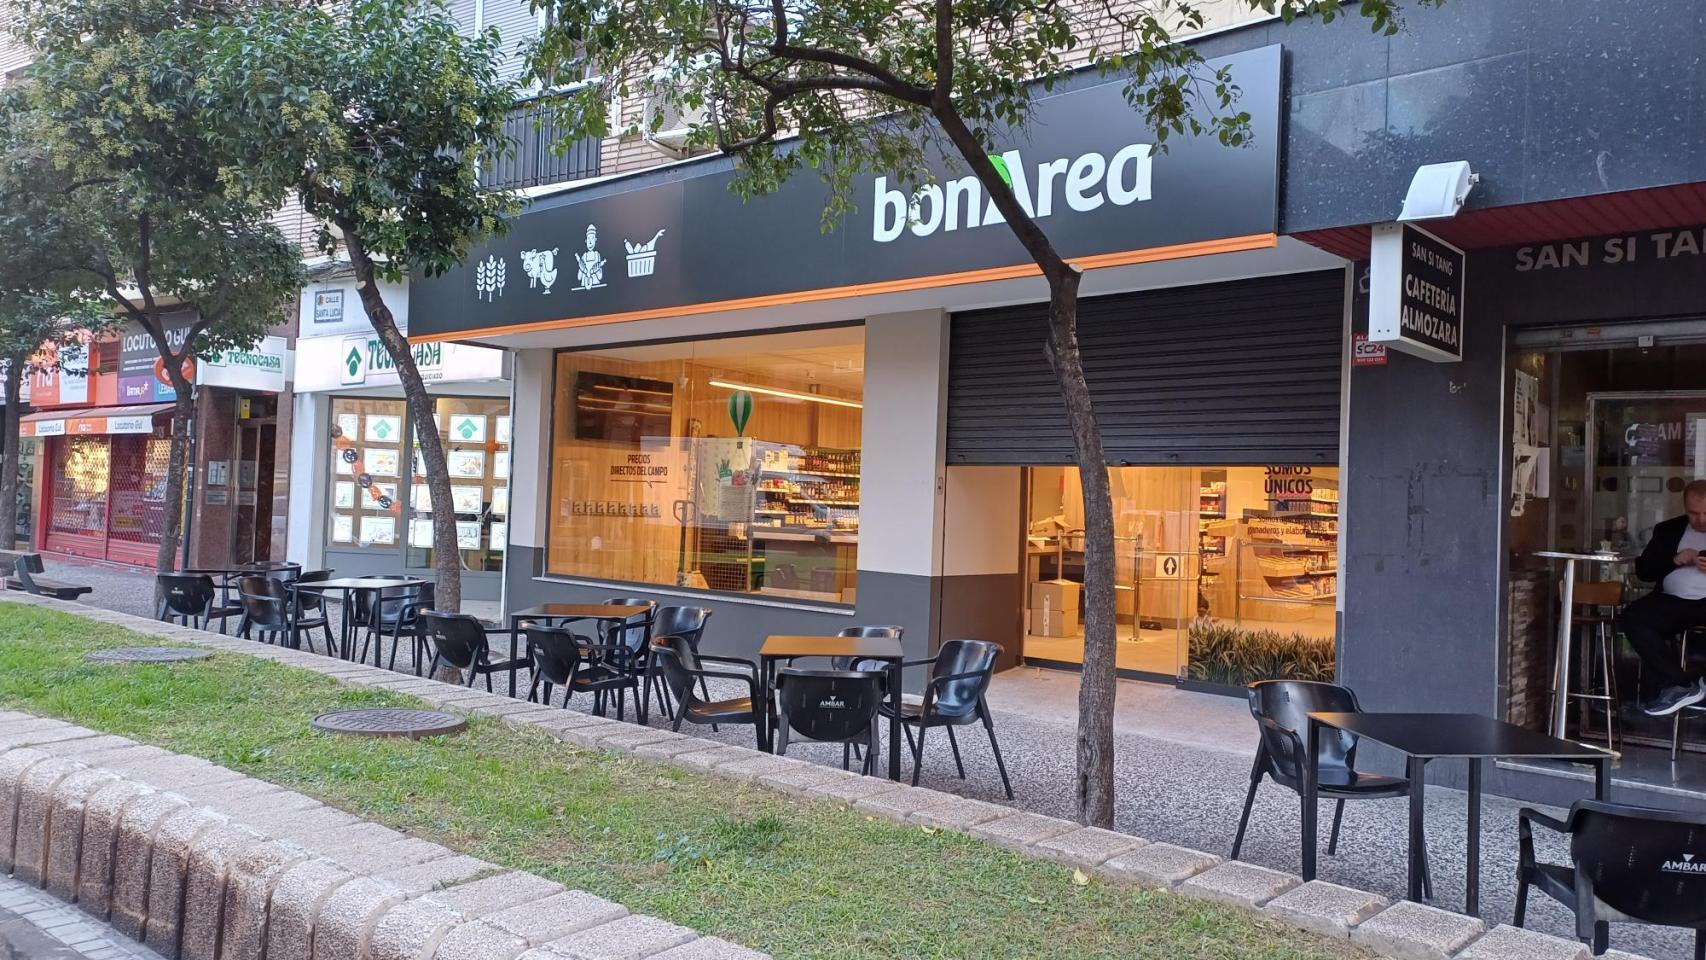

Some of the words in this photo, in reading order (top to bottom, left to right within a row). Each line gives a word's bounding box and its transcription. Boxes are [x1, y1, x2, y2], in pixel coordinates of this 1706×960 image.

[1515, 242, 1589, 271] SAN
[1602, 237, 1637, 264] SI
[1651, 228, 1706, 259] TA
[1411, 242, 1427, 263] SAN
[1428, 250, 1435, 267] SI
[1436, 254, 1453, 276] TANG
[325, 295, 340, 303] CALLE
[1405, 273, 1456, 316] CAFETERÍA
[316, 309, 329, 318] SANTA
[1401, 305, 1458, 347] ALMOZARA
[228, 350, 281, 369] TECNOCASA
[627, 454, 650, 464] PRECIOS
[610, 466, 636, 476] DIRECTOS
[637, 466, 647, 476] DEL
[648, 466, 668, 476] CAMPO
[1264, 465, 1311, 475] SOMOS
[1264, 475, 1313, 494] ÚNICOS
[1662, 860, 1706, 872] AMBAR
